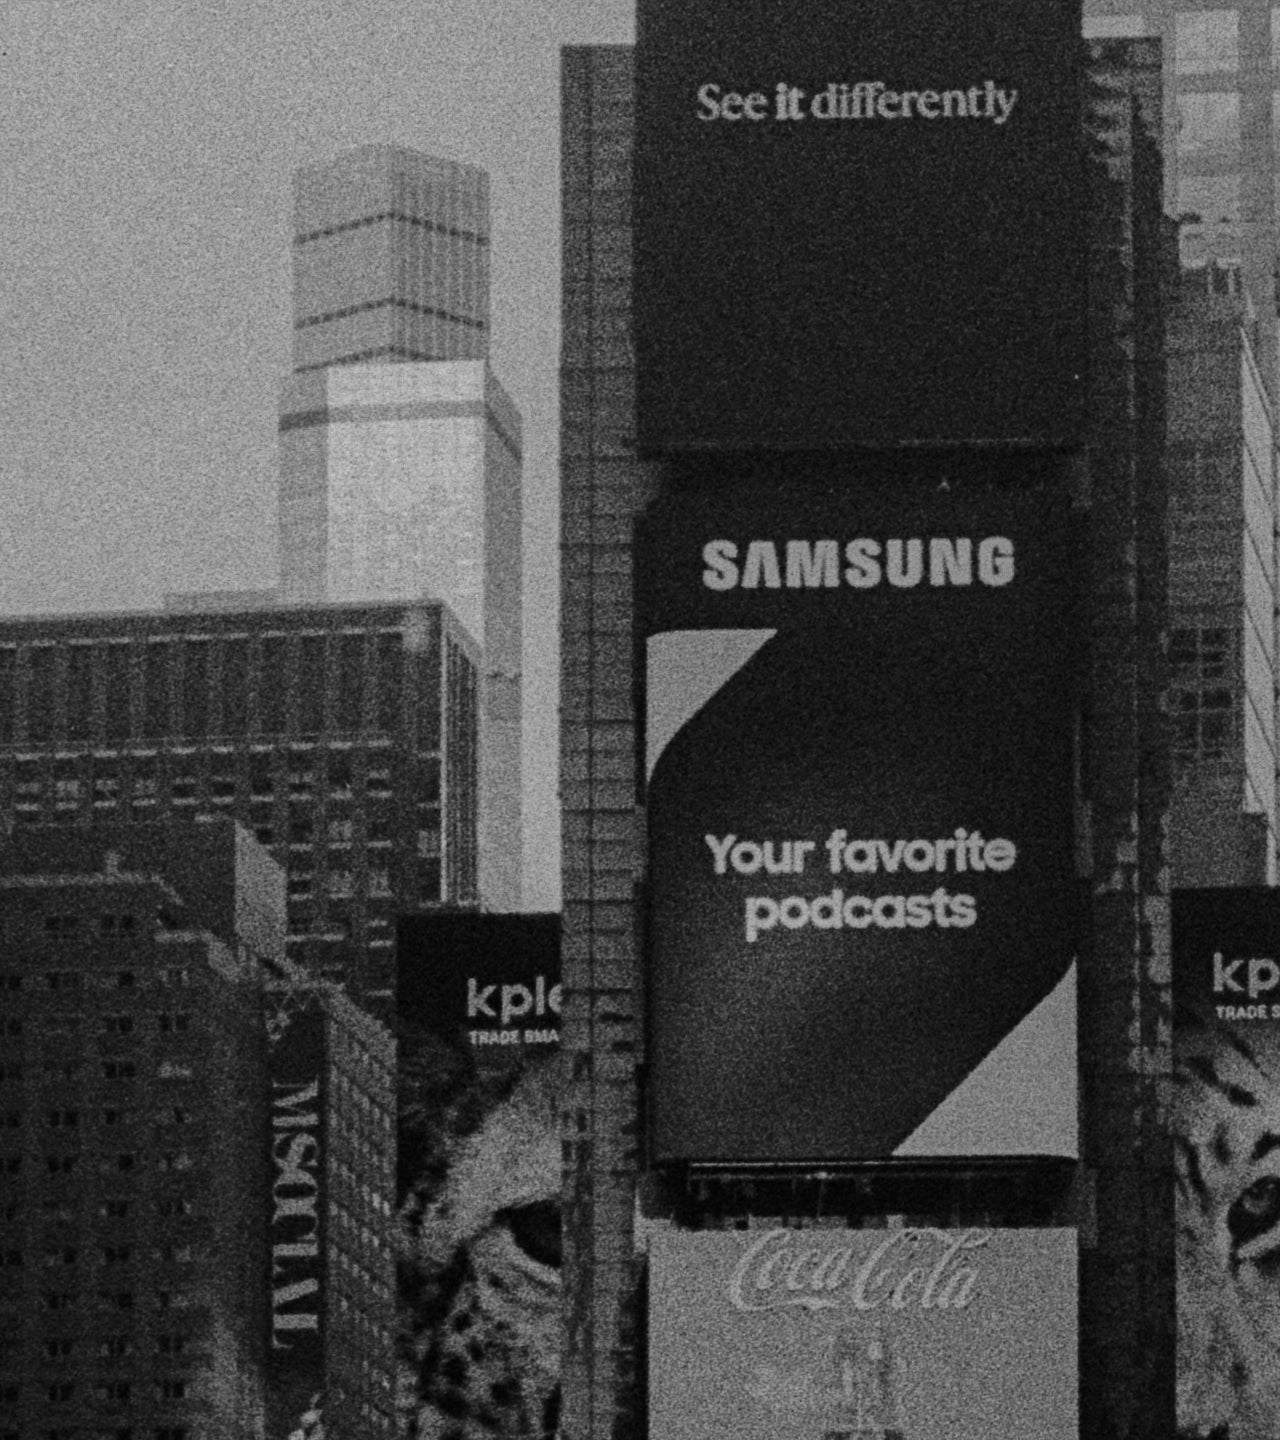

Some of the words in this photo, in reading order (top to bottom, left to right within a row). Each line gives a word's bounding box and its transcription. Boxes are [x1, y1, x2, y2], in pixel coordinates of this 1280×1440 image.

[695, 82, 769, 122] See
[774, 81, 809, 122] it
[810, 79, 1019, 126] differently
[702, 535, 1019, 591] SAMSUNG
[705, 830, 816, 879] Your
[825, 826, 1020, 877] favorite
[744, 886, 979, 943] podcasts
[1214, 1004, 1267, 1019] TRADE
[469, 1029, 521, 1045] TRADE
